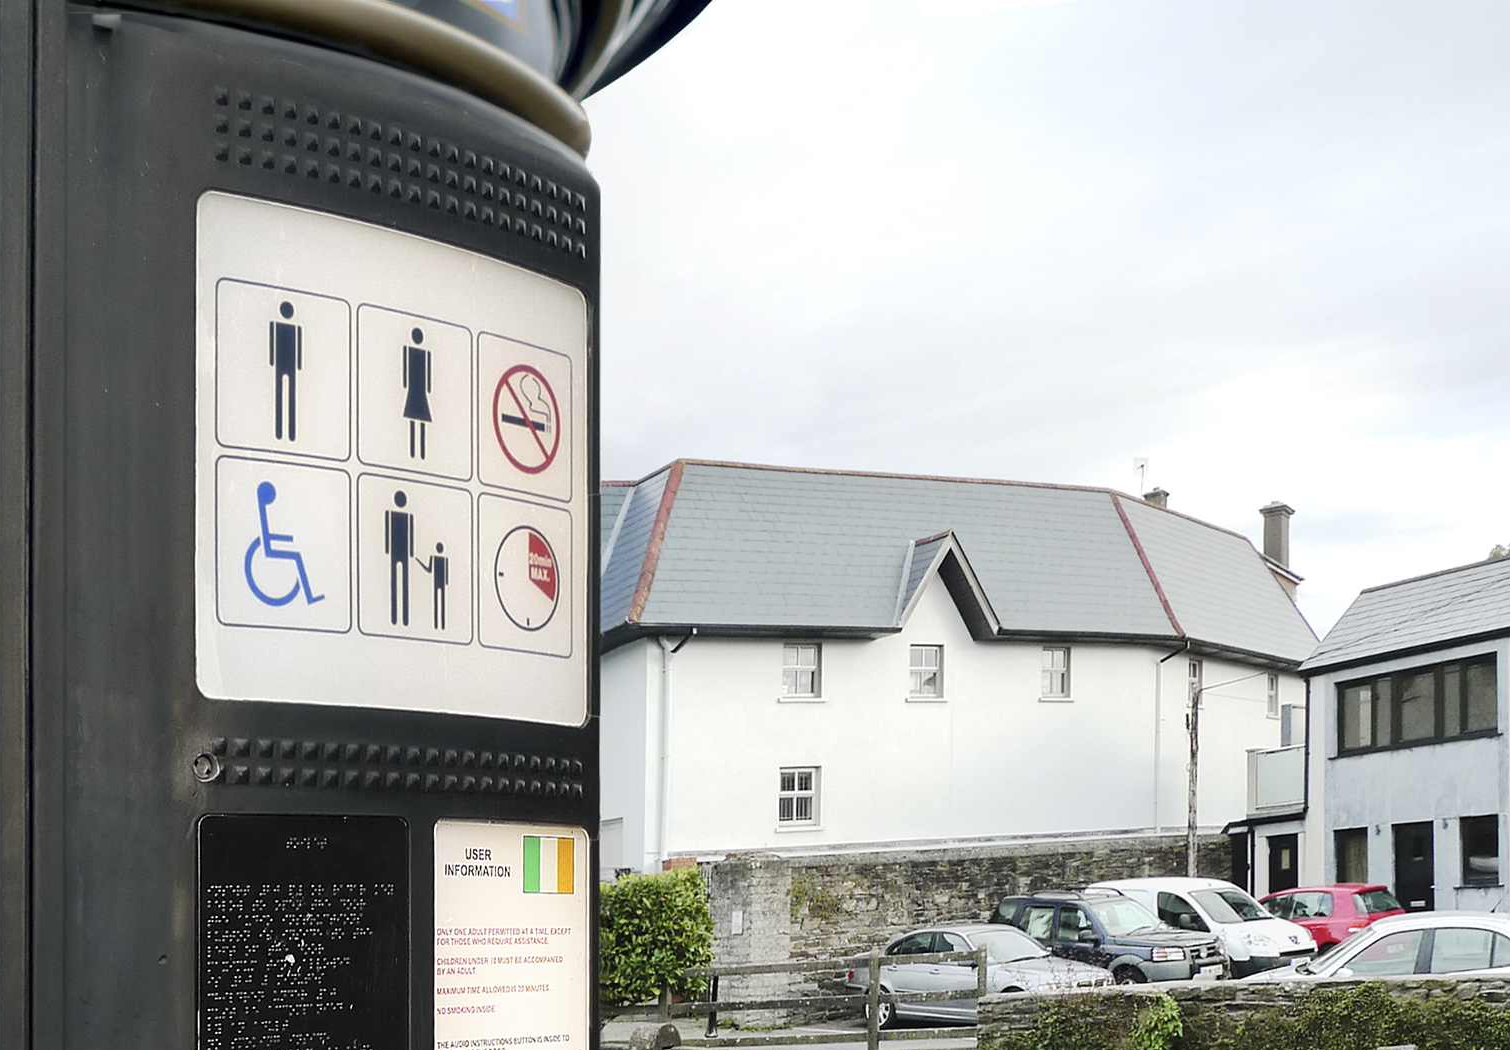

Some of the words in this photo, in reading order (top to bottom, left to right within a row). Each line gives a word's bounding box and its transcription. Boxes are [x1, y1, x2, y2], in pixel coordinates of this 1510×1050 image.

[529, 552, 552, 568] 20min
[531, 567, 550, 582] MAX.
[465, 848, 491, 860] USER
[445, 864, 511, 877] INFORMATION
